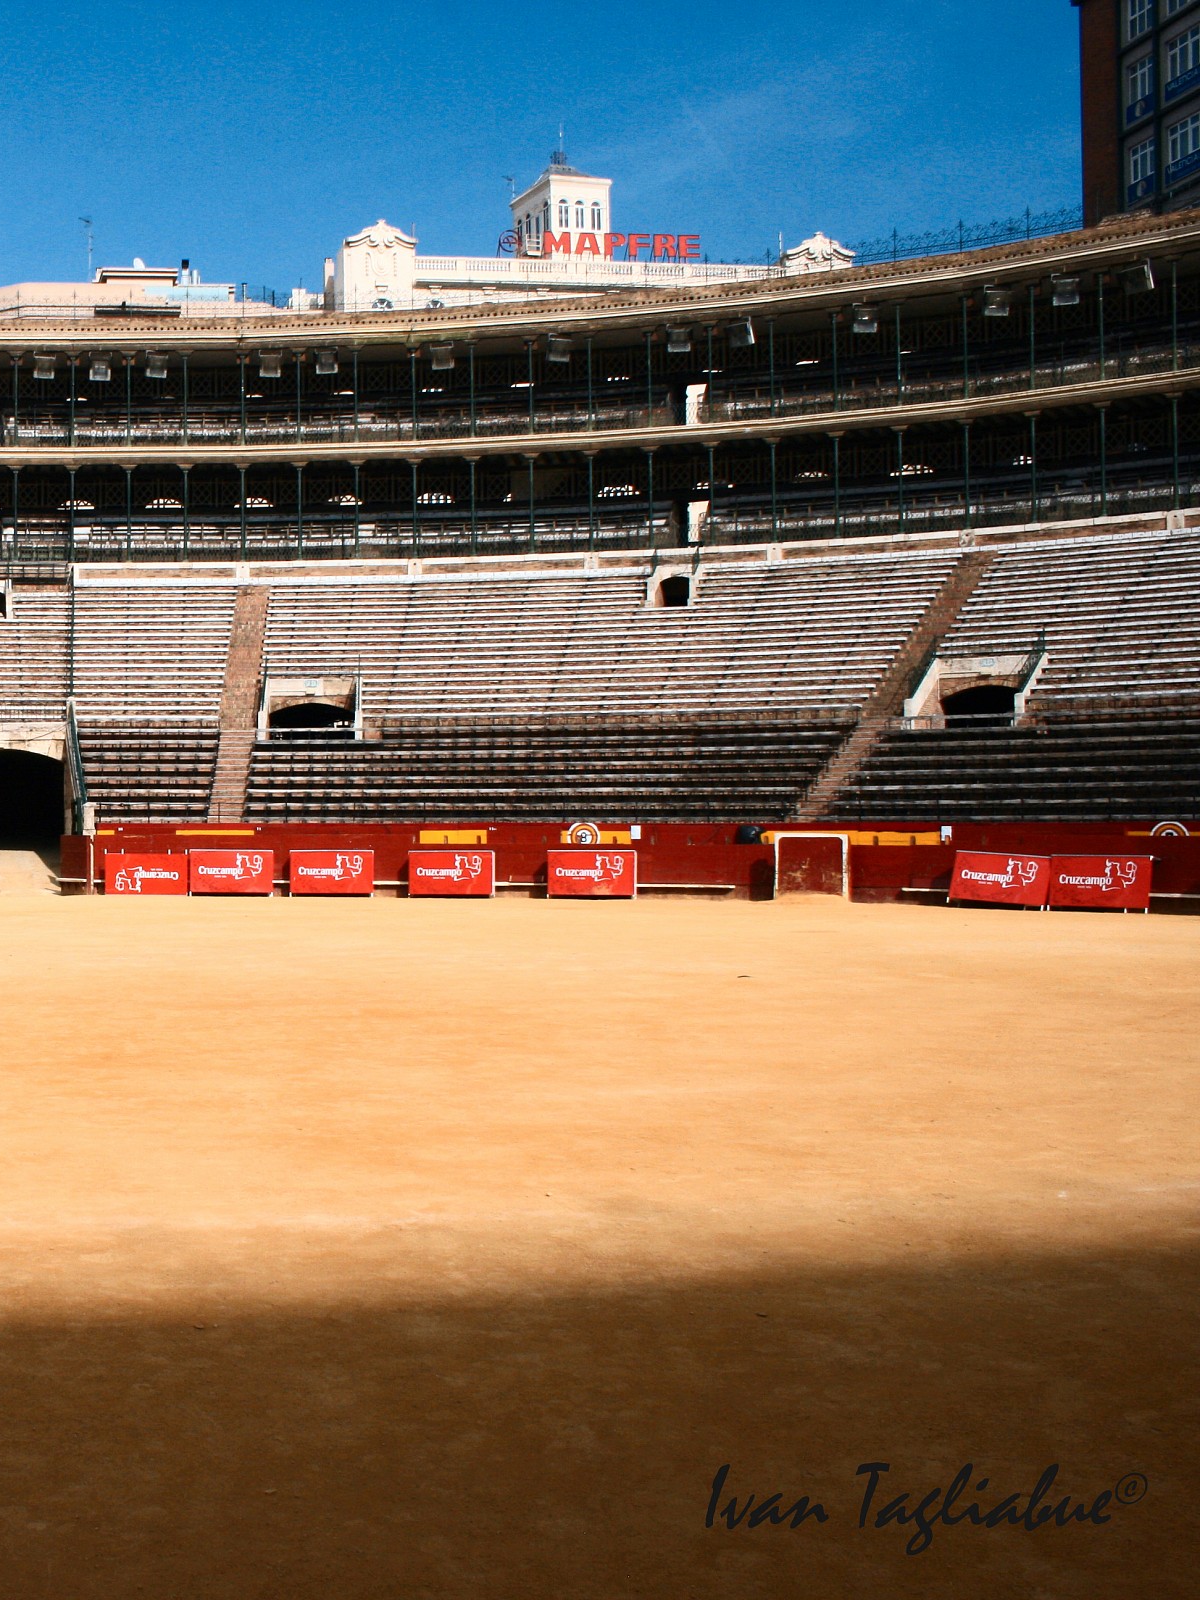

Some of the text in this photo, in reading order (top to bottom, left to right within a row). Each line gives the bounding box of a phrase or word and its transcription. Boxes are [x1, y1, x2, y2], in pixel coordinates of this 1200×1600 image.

[543, 231, 700, 258] MAPFRE
[134, 871, 179, 880] Cruzcampo
[198, 866, 243, 877] Cruzcampo
[298, 866, 343, 877] Cruzcampo
[416, 867, 462, 878] Cruzcampo
[555, 867, 603, 878] Cruzcampo
[961, 869, 1013, 883] Cruzcampo
[1059, 873, 1112, 886] Cruzcampo
